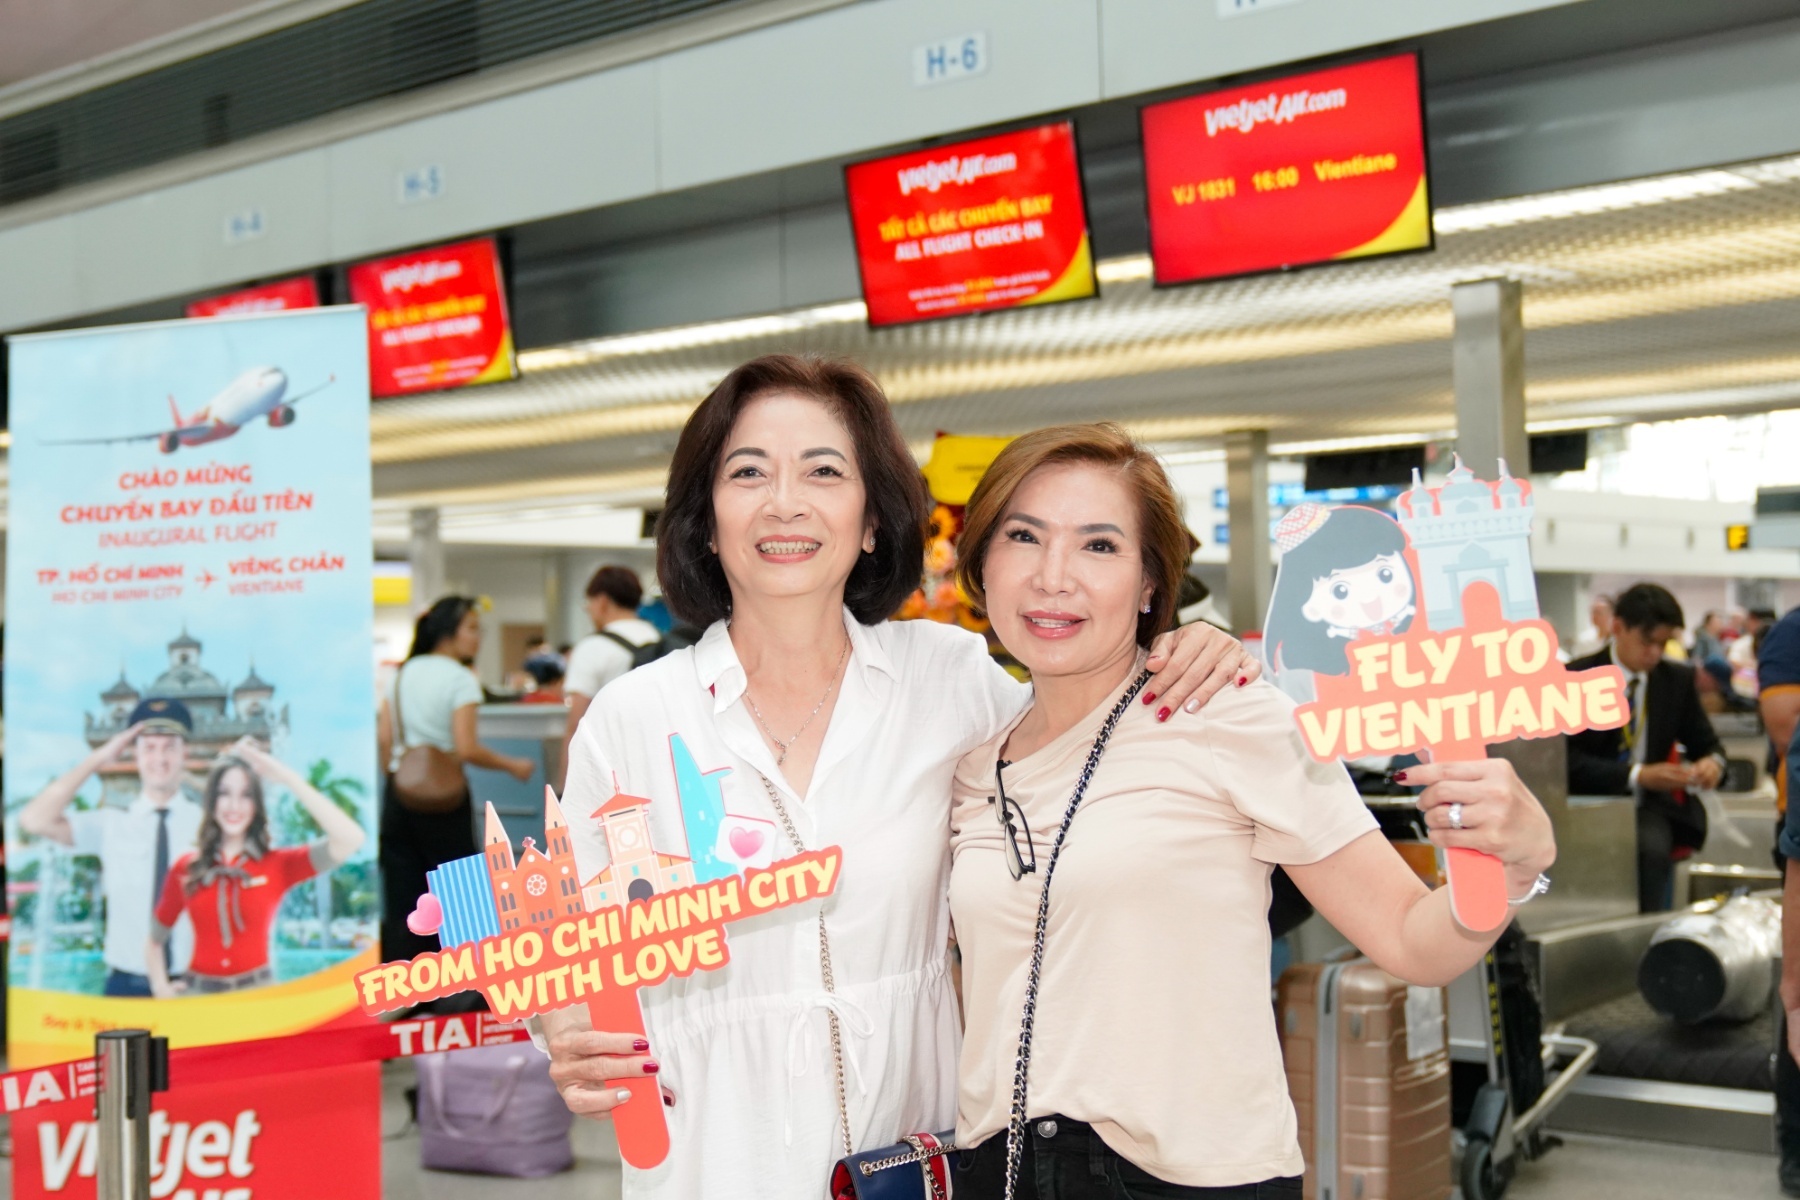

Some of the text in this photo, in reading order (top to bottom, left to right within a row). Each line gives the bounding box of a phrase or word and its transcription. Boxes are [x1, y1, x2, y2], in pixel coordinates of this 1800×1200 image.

[927, 39, 978, 78] H-6
[1172, 186, 1196, 206] VJ
[1252, 166, 1299, 192] 16:00
[1314, 152, 1397, 182] Vientiane
[895, 219, 1044, 262] ALL FLIGHT CHECK-IN
[161, 499, 203, 519] BAY
[98, 520, 278, 549] INAUGURAL FLIGHT
[138, 565, 184, 580] MINH
[228, 579, 304, 596] VIENTIANE
[1353, 627, 1550, 693] FLY TO
[1299, 676, 1622, 757] VIENTIANE
[358, 854, 838, 1007] FROM HO CHI MINH CITY
[486, 930, 725, 1017] WITH LOVE
[390, 1017, 472, 1056] TIA
[0, 1070, 65, 1112] IA
[38, 1109, 261, 1198] Vitjet
